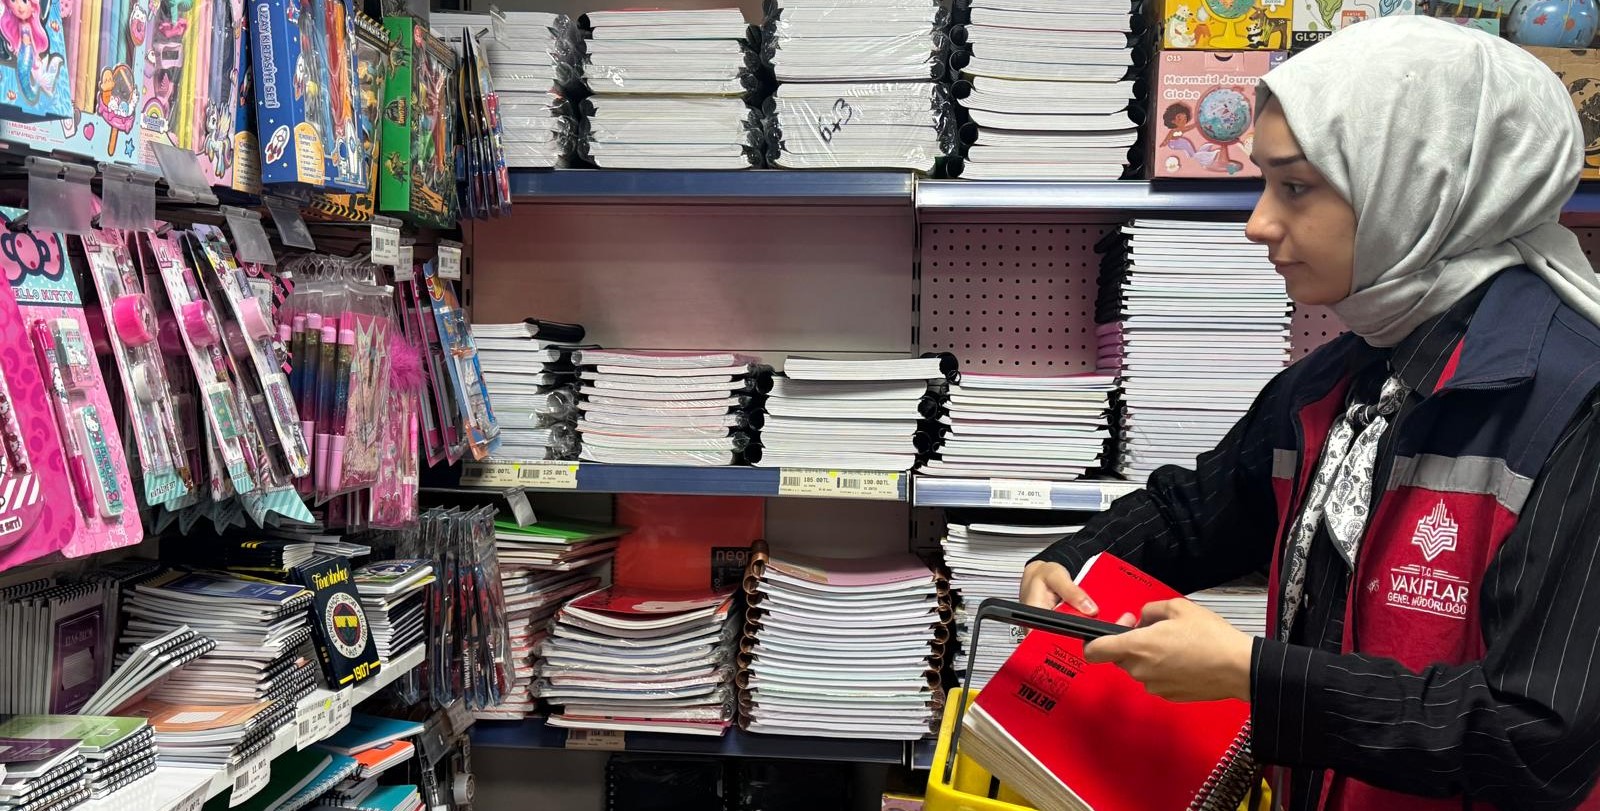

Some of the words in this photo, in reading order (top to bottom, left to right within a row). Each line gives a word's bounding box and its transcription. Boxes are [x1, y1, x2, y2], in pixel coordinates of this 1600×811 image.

[257, 3, 271, 34] UZAY
[1164, 74, 1219, 85] Mermaid
[1220, 75, 1260, 85] Journ
[1163, 89, 1200, 99] Globe
[1391, 574, 1469, 604] VAKIFLAR
[1387, 592, 1410, 605] GENEL
[353, 662, 370, 681] 1907
